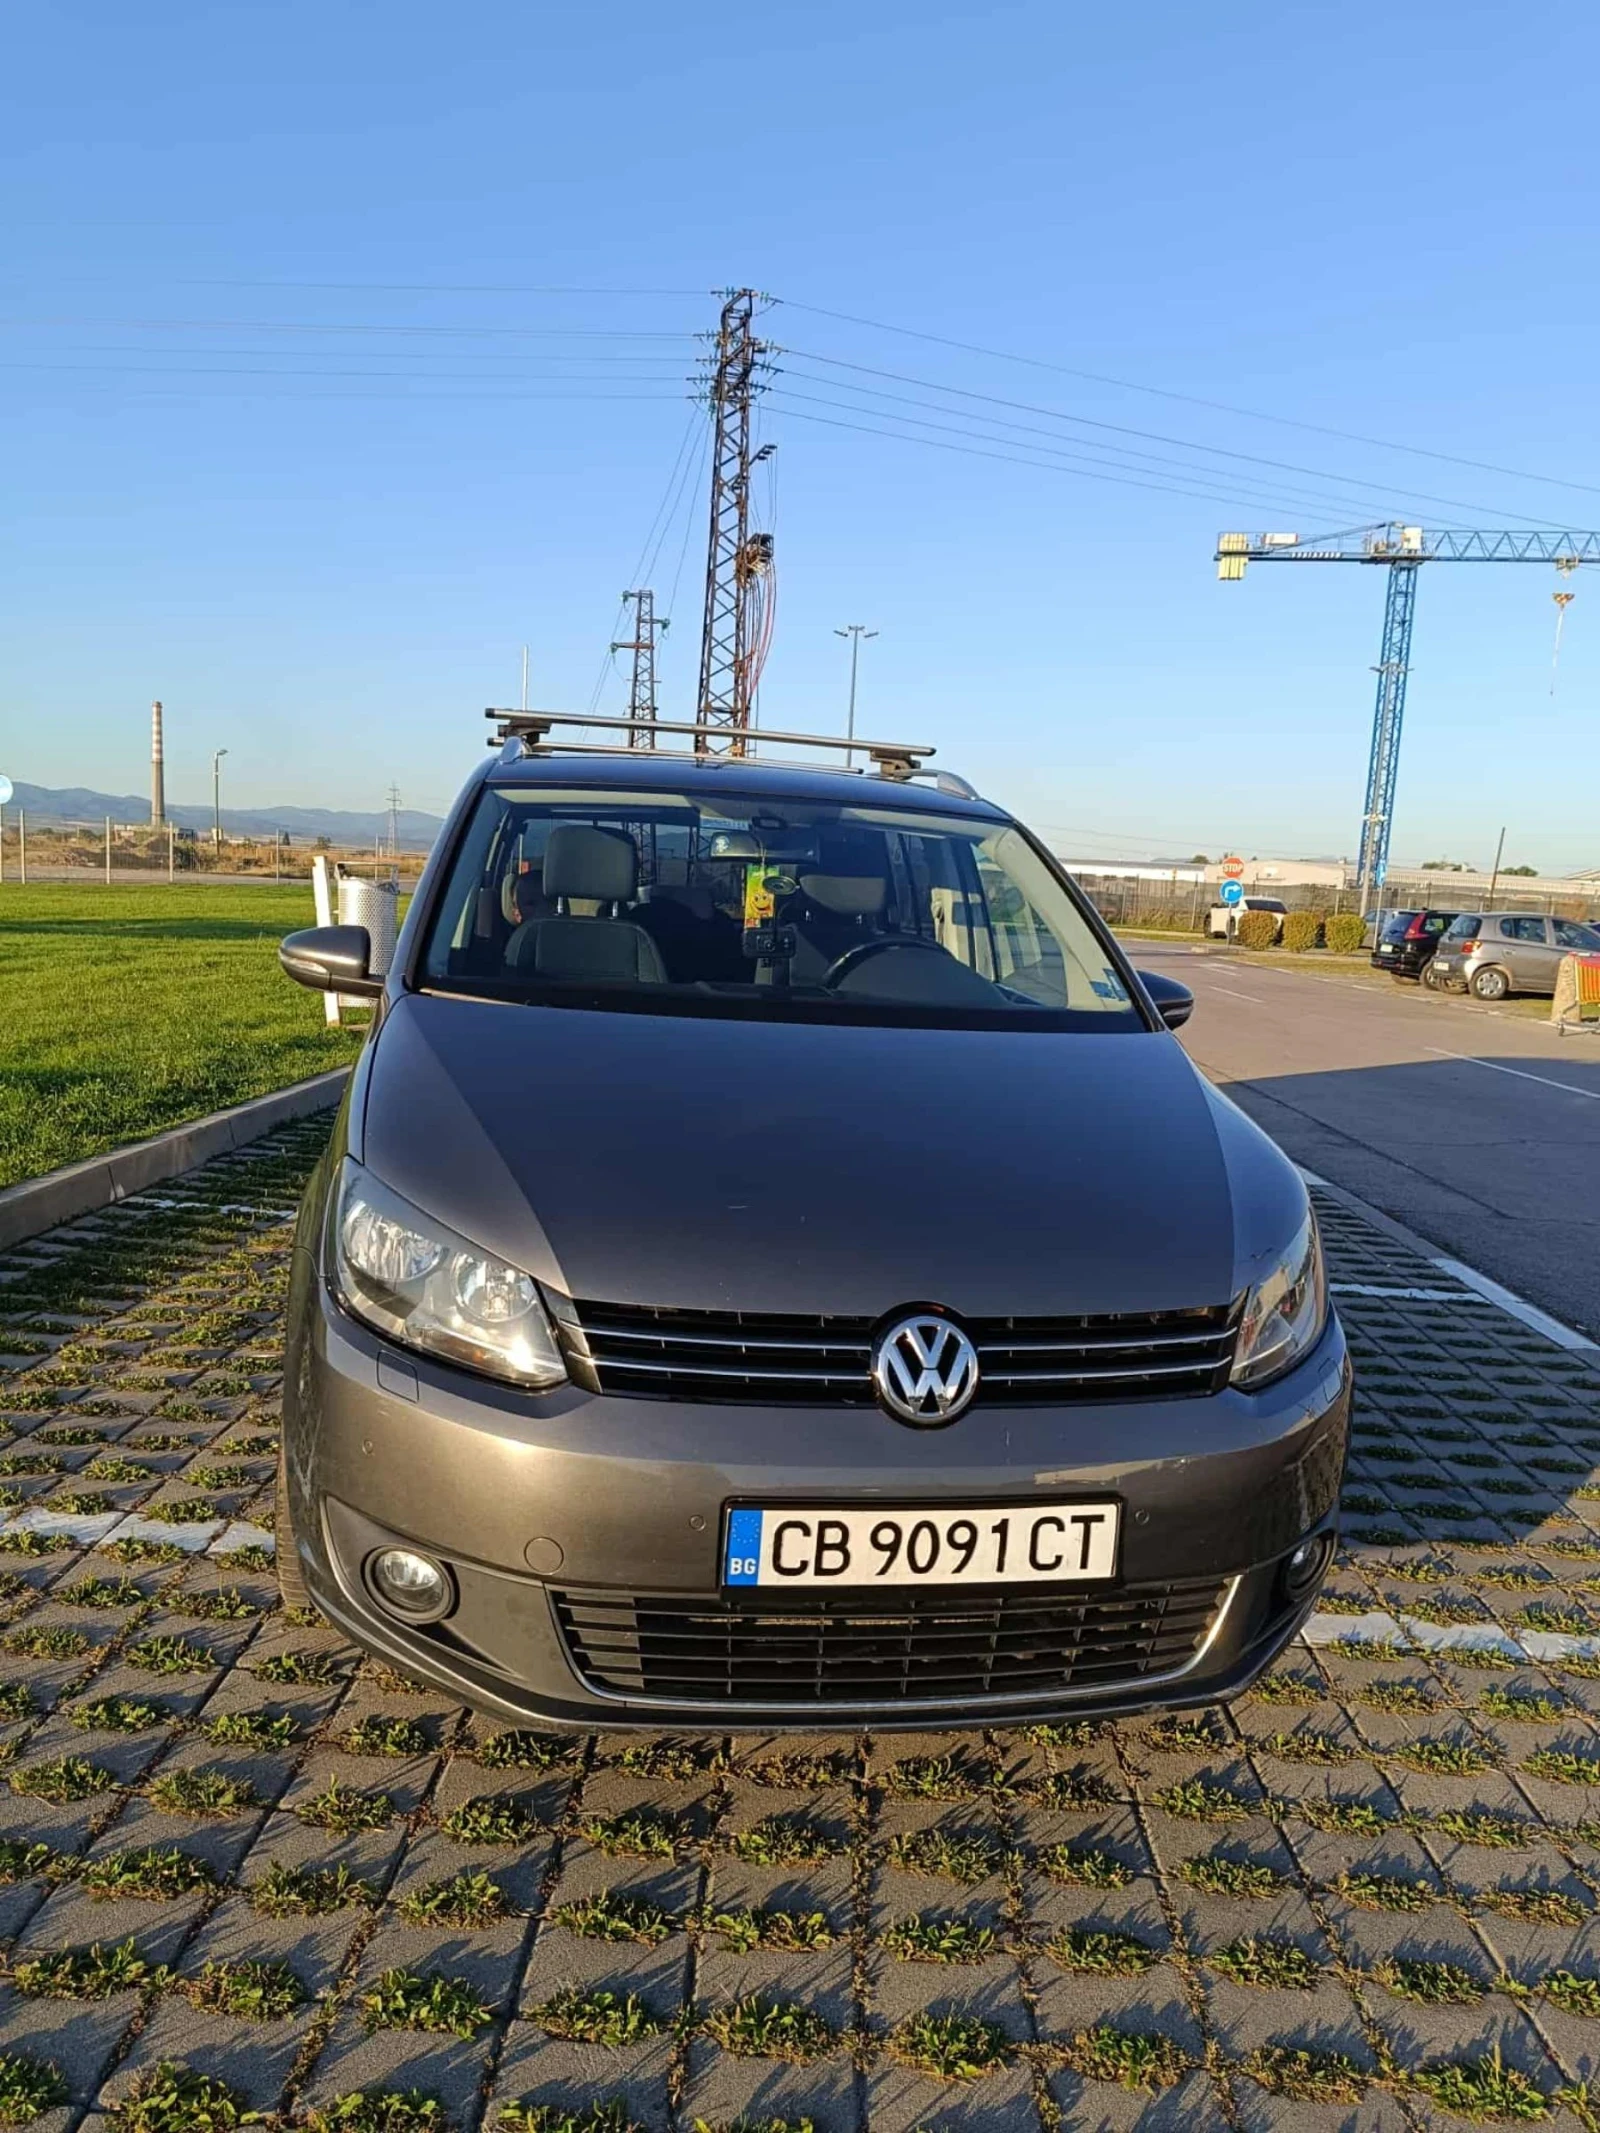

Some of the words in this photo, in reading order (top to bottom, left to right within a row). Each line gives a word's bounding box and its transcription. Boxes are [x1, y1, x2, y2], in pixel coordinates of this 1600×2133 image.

[880, 1317, 976, 1420] VW
[730, 1557, 757, 1575] BG
[772, 1519, 851, 1577] CB
[870, 1518, 1009, 1576] 9091
[1029, 1514, 1105, 1571] CT
